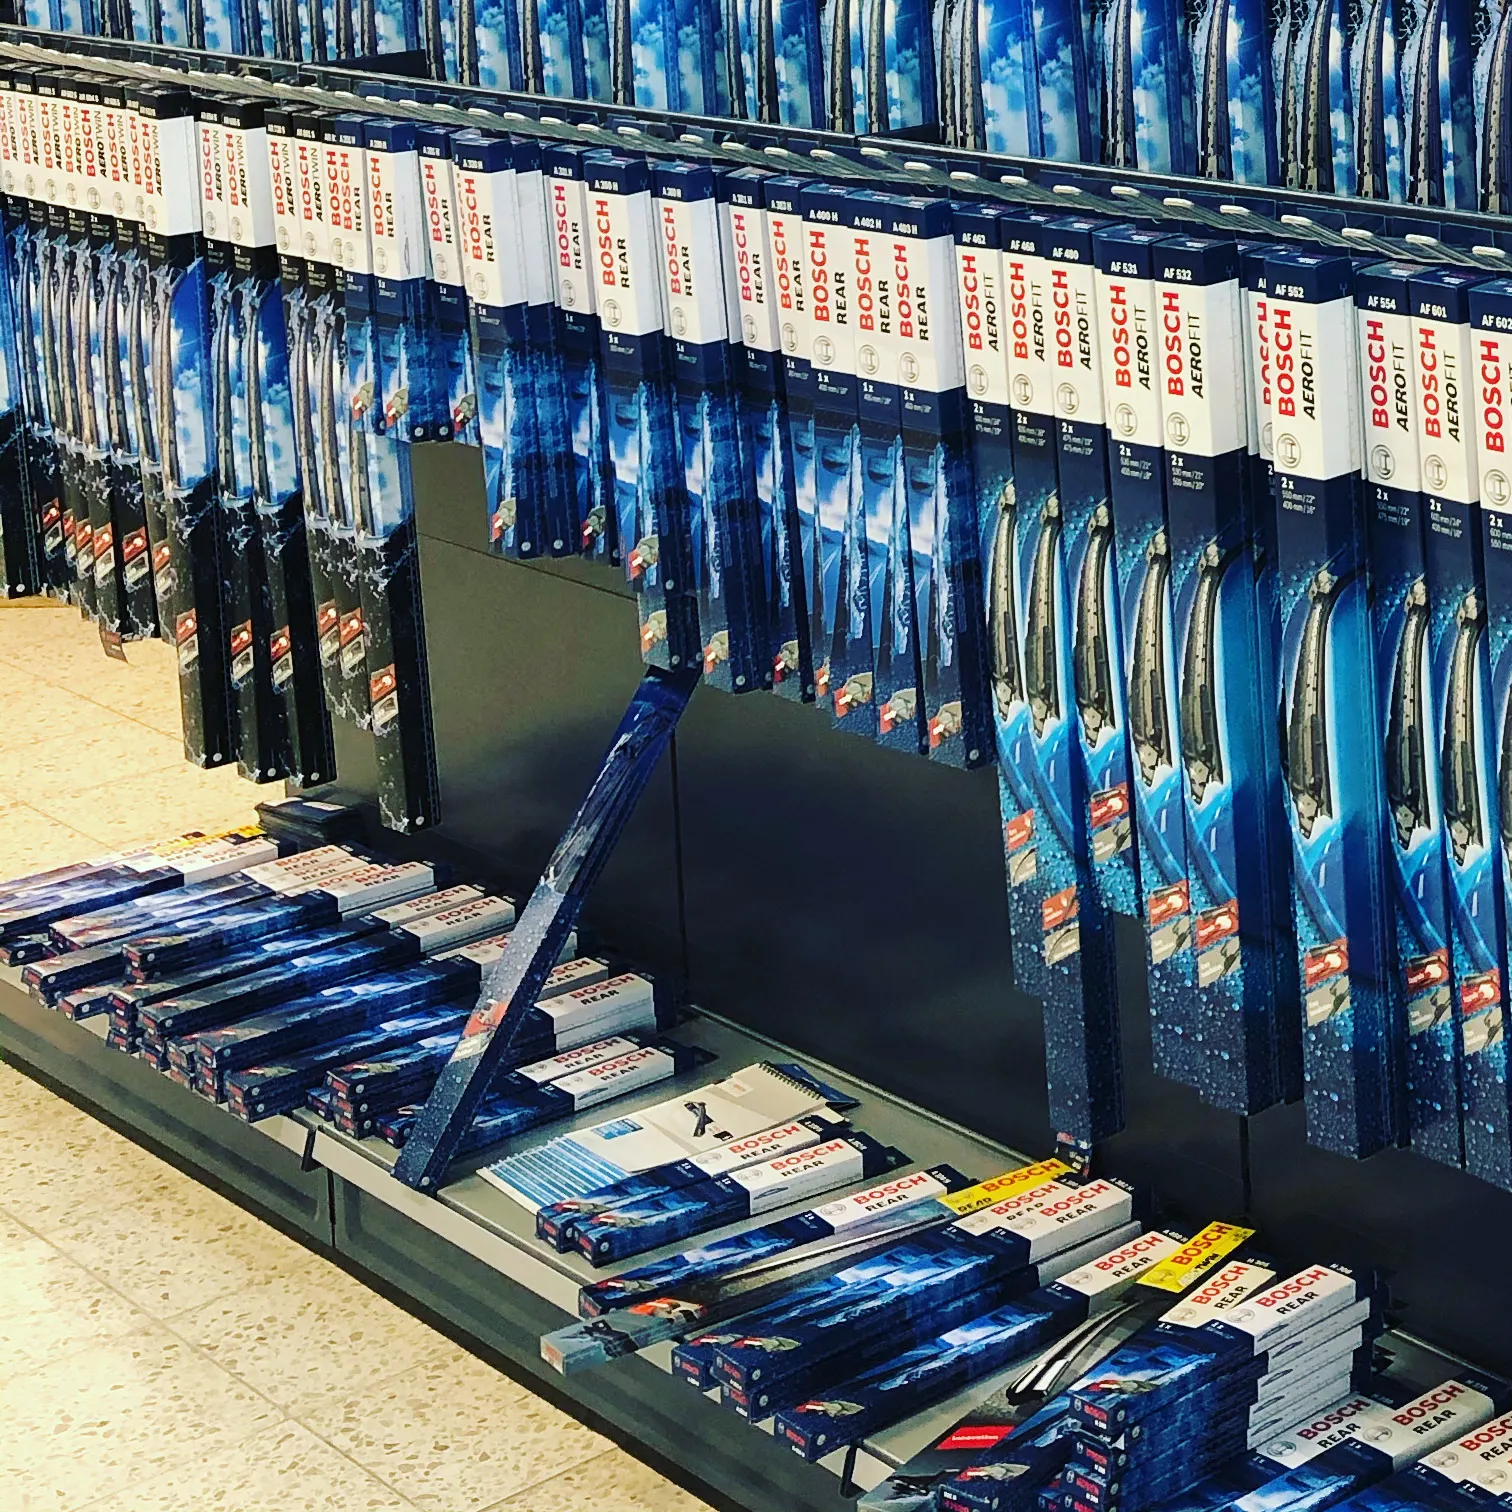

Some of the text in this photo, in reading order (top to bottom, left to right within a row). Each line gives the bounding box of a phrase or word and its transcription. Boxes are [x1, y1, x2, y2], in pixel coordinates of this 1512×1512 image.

[226, 133, 239, 206] BOSCH
[595, 200, 616, 286] BOSCH
[617, 239, 629, 288] REAR
[810, 231, 830, 322] BOSCH
[1164, 268, 1192, 280] AF 532
[835, 272, 847, 324] REAR
[1163, 292, 1184, 396] BOSCH
[1188, 313, 1203, 399] AEROFIT
[436, 899, 497, 921] BOSCH
[445, 910, 482, 926] REAR
[570, 975, 635, 1000] BOSCH
[580, 988, 619, 1006] REAR
[770, 1142, 844, 1170] BOSCH
[781, 1160, 824, 1176] REAR
[1042, 1185, 1109, 1217] BOSCH
[1056, 1204, 1097, 1224] REAR
[1094, 1236, 1162, 1270] BOSCH
[1171, 1225, 1233, 1266] BOSCH
[1111, 1255, 1153, 1278] REAR
[1255, 1269, 1329, 1308] BOSCH
[1276, 1291, 1319, 1315] REAR
[1392, 1384, 1466, 1426] BOSCH
[1413, 1409, 1457, 1435] REAR
